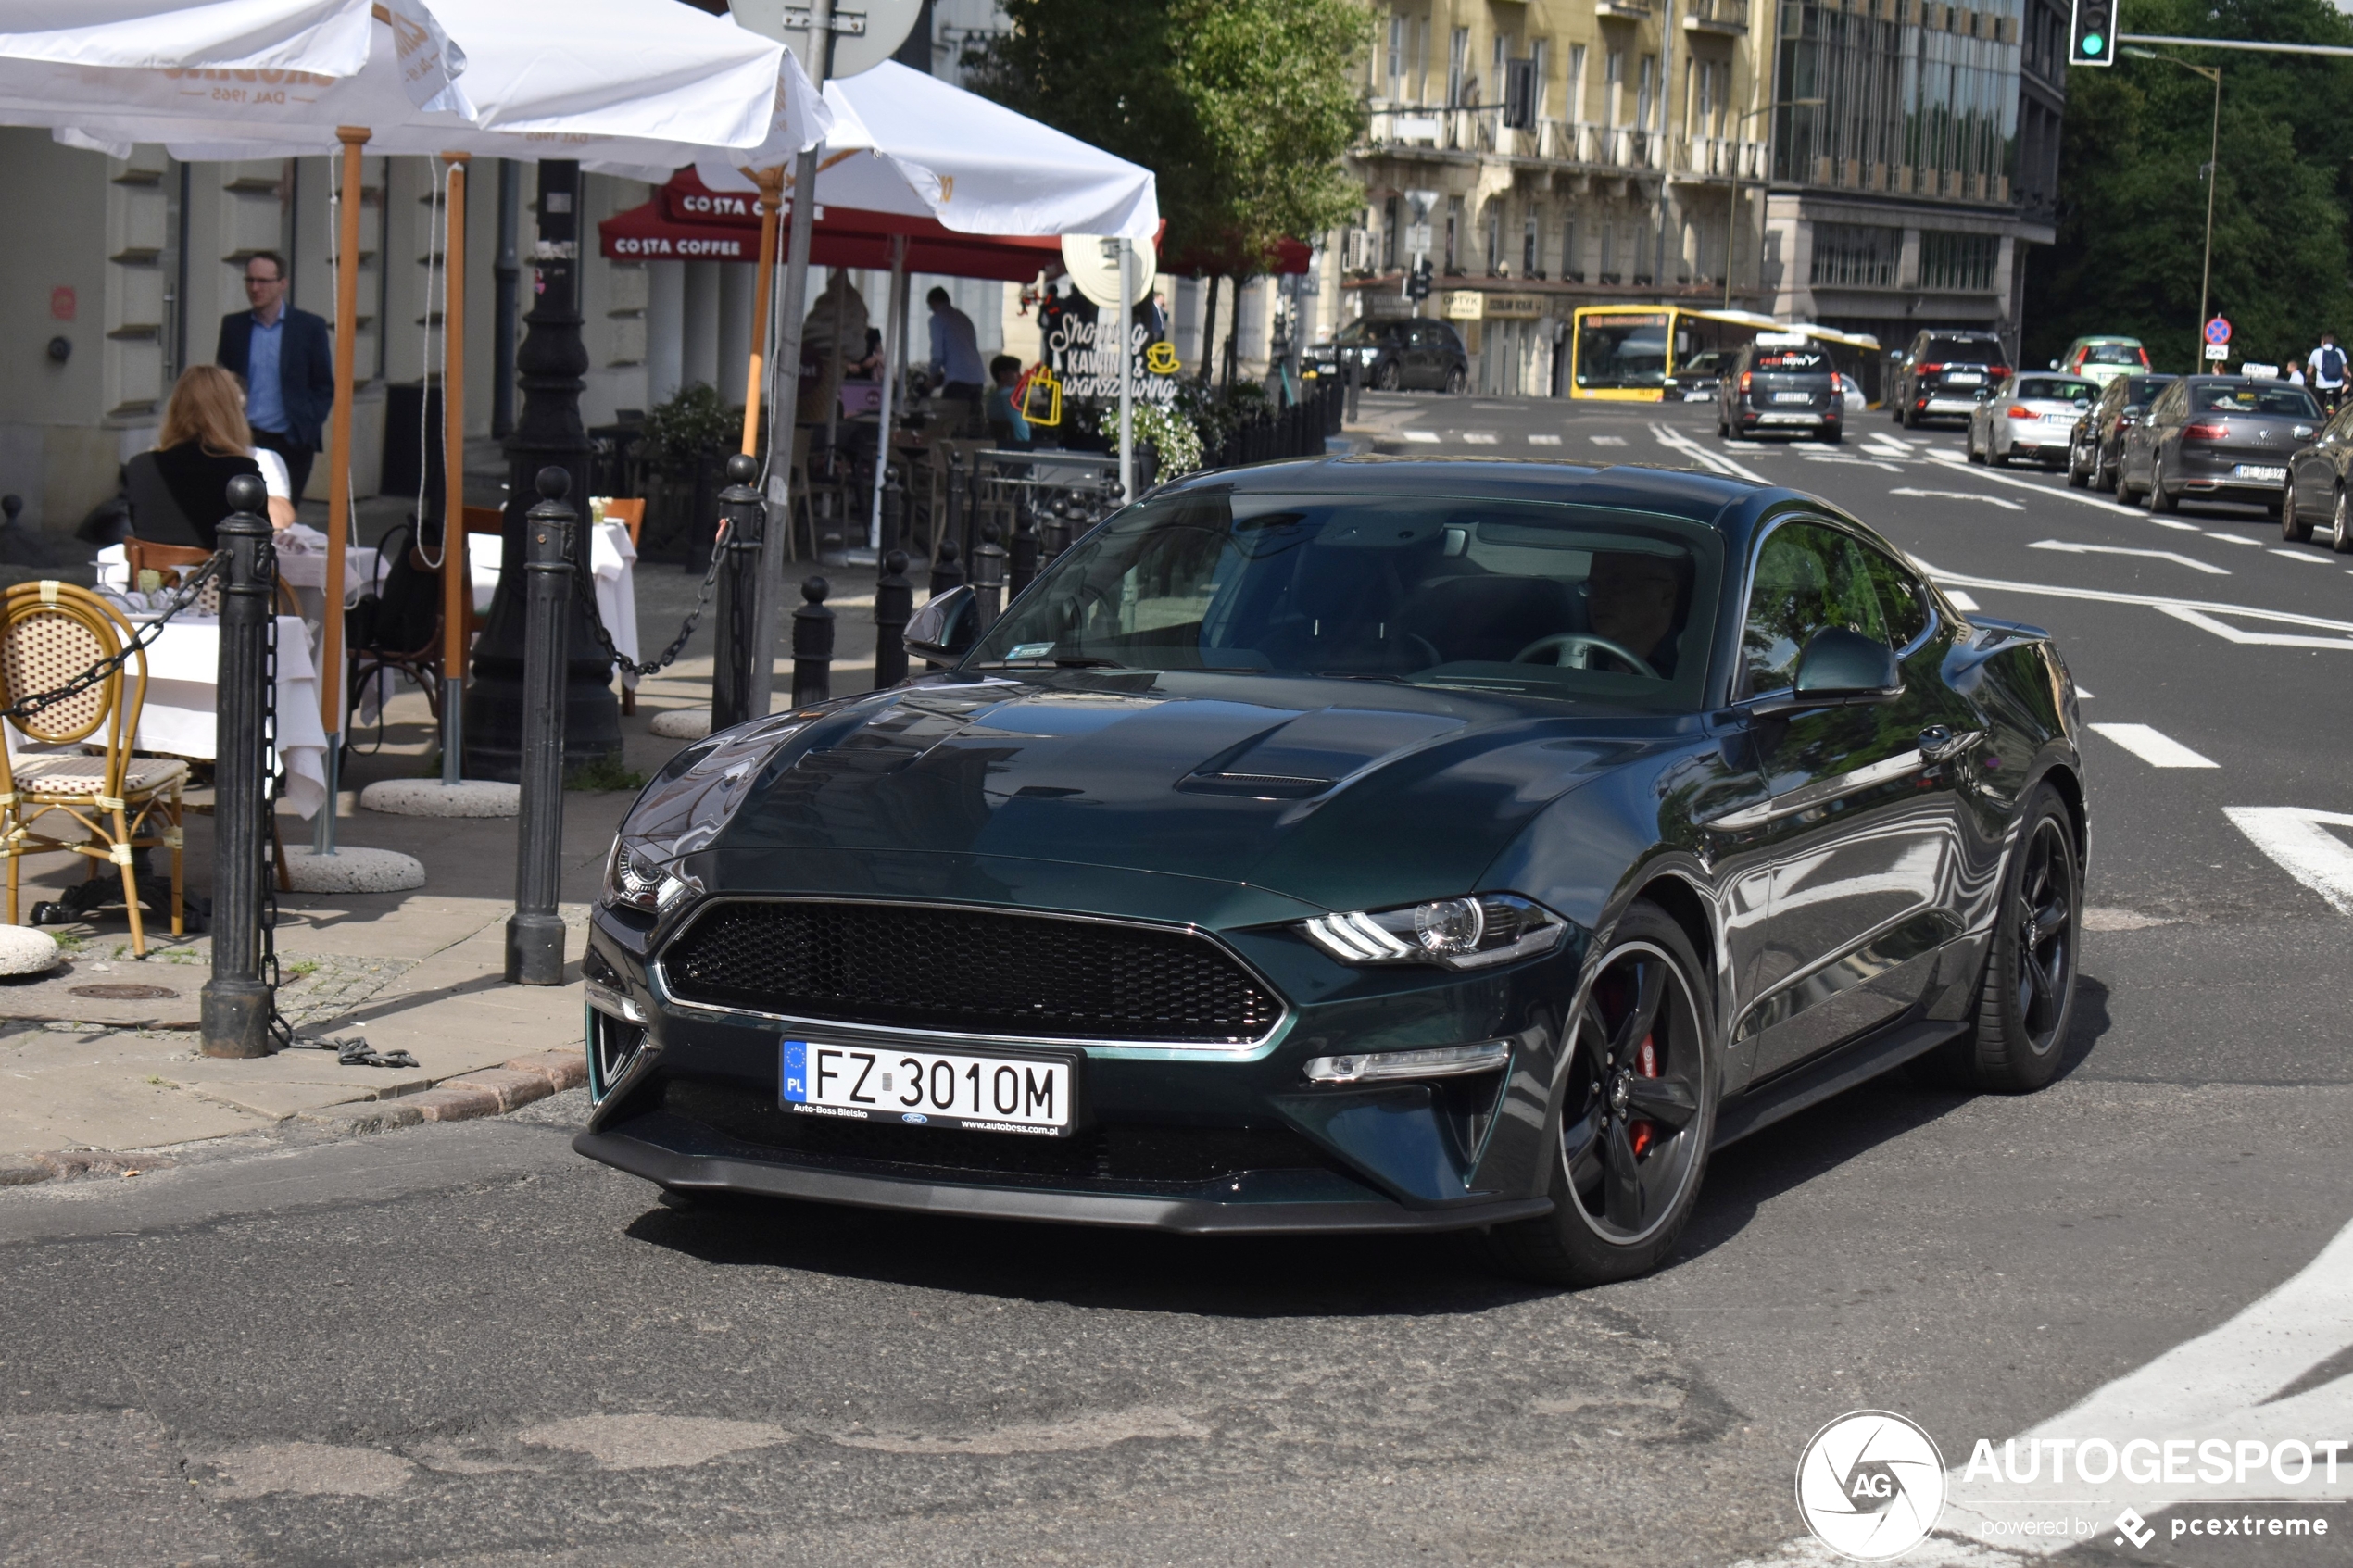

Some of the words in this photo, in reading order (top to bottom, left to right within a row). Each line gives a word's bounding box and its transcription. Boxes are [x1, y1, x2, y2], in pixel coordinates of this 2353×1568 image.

[683, 195, 746, 215] COSTA
[615, 238, 671, 255] COSTA
[676, 239, 740, 256] COFFEE
[1062, 373, 1178, 405] warszwing
[787, 1078, 804, 1092] PL
[817, 1049, 876, 1103] FZ
[899, 1058, 1053, 1119] 3010M
[793, 1103, 837, 1115] Auto-Boss
[837, 1107, 868, 1119] Bielsko
[961, 1120, 1059, 1135] www.autoboss.com.pl
